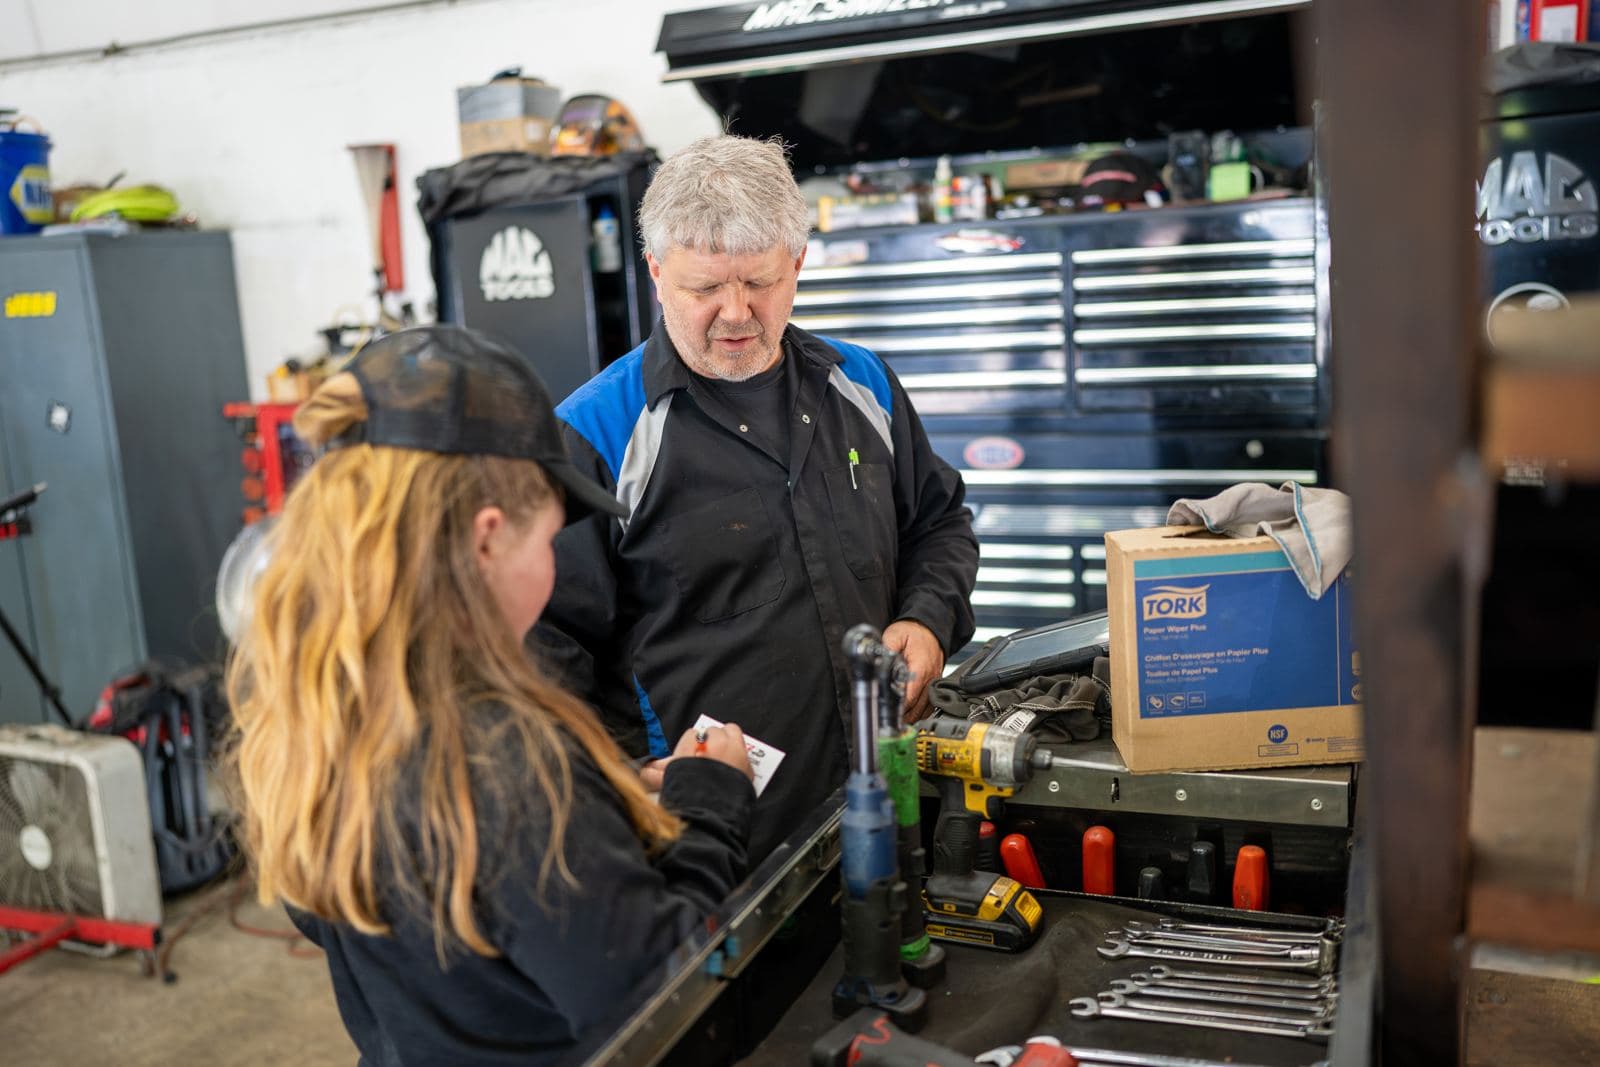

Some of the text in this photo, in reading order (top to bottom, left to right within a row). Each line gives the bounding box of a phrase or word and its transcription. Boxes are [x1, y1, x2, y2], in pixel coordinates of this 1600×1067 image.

[1475, 213, 1598, 245] OOLS
[1146, 597, 1202, 616] TORK
[1190, 623, 1207, 631] Plus
[1252, 647, 1269, 655] Plus
[1202, 666, 1218, 674] Plus
[1270, 728, 1286, 739] NSF
